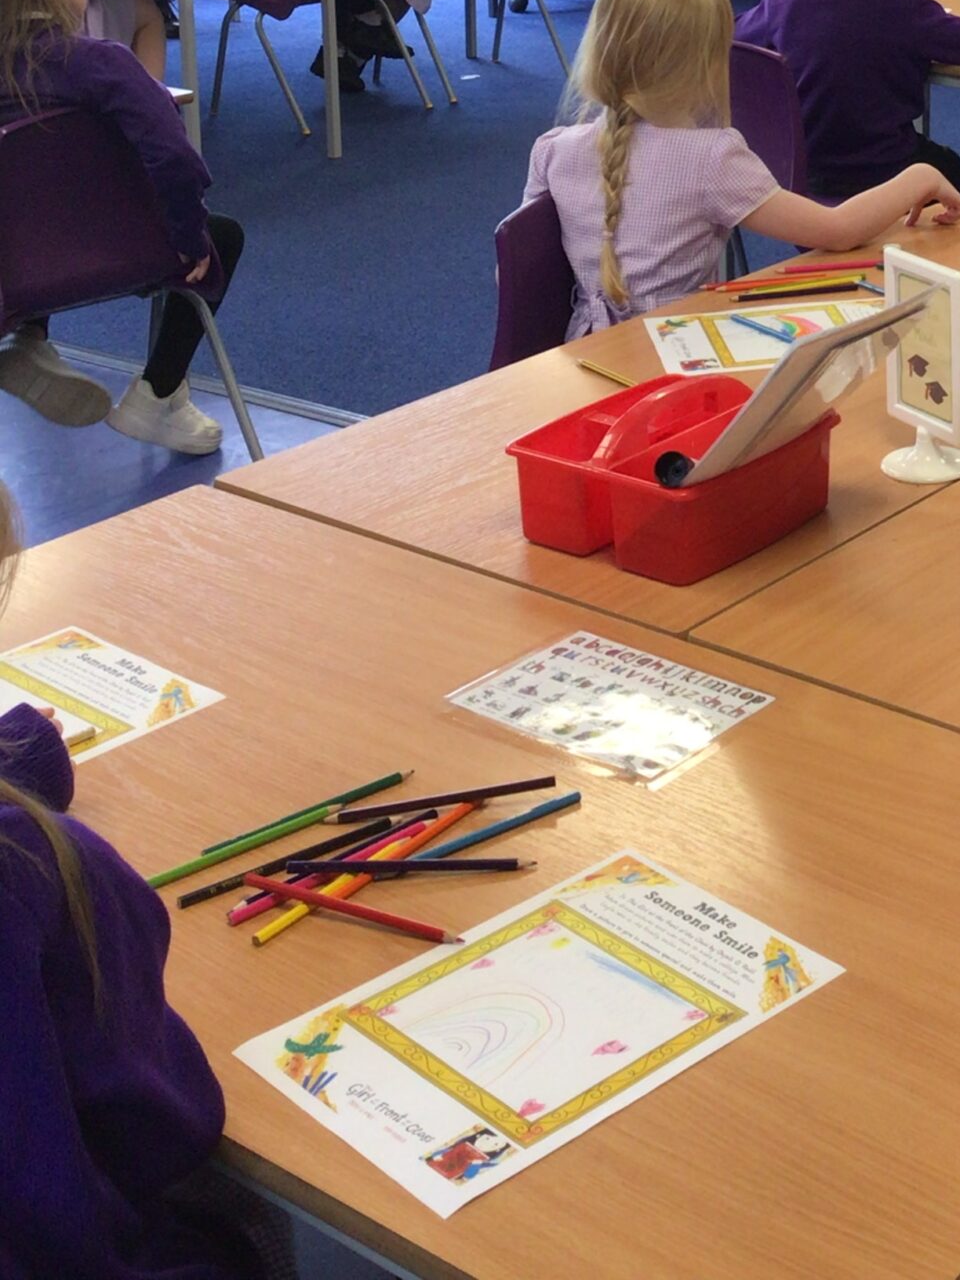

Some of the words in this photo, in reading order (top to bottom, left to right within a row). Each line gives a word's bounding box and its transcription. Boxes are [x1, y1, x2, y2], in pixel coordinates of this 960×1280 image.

[570, 637, 586, 645] a
[584, 639, 600, 649] b
[596, 645, 612, 653] c
[618, 652, 636, 660] e
[115, 658, 147, 675] Make
[632, 658, 653, 667] g
[646, 660, 664, 670] h
[76, 653, 124, 677] Someone
[124, 676, 158, 693] Smile
[680, 671, 697, 682] k
[702, 678, 727, 692] m
[724, 687, 742, 696] n
[739, 692, 754, 700] o
[745, 695, 766, 706] p
[693, 902, 737, 928] Make
[644, 891, 710, 931] Someone
[713, 930, 758, 958] Smile
